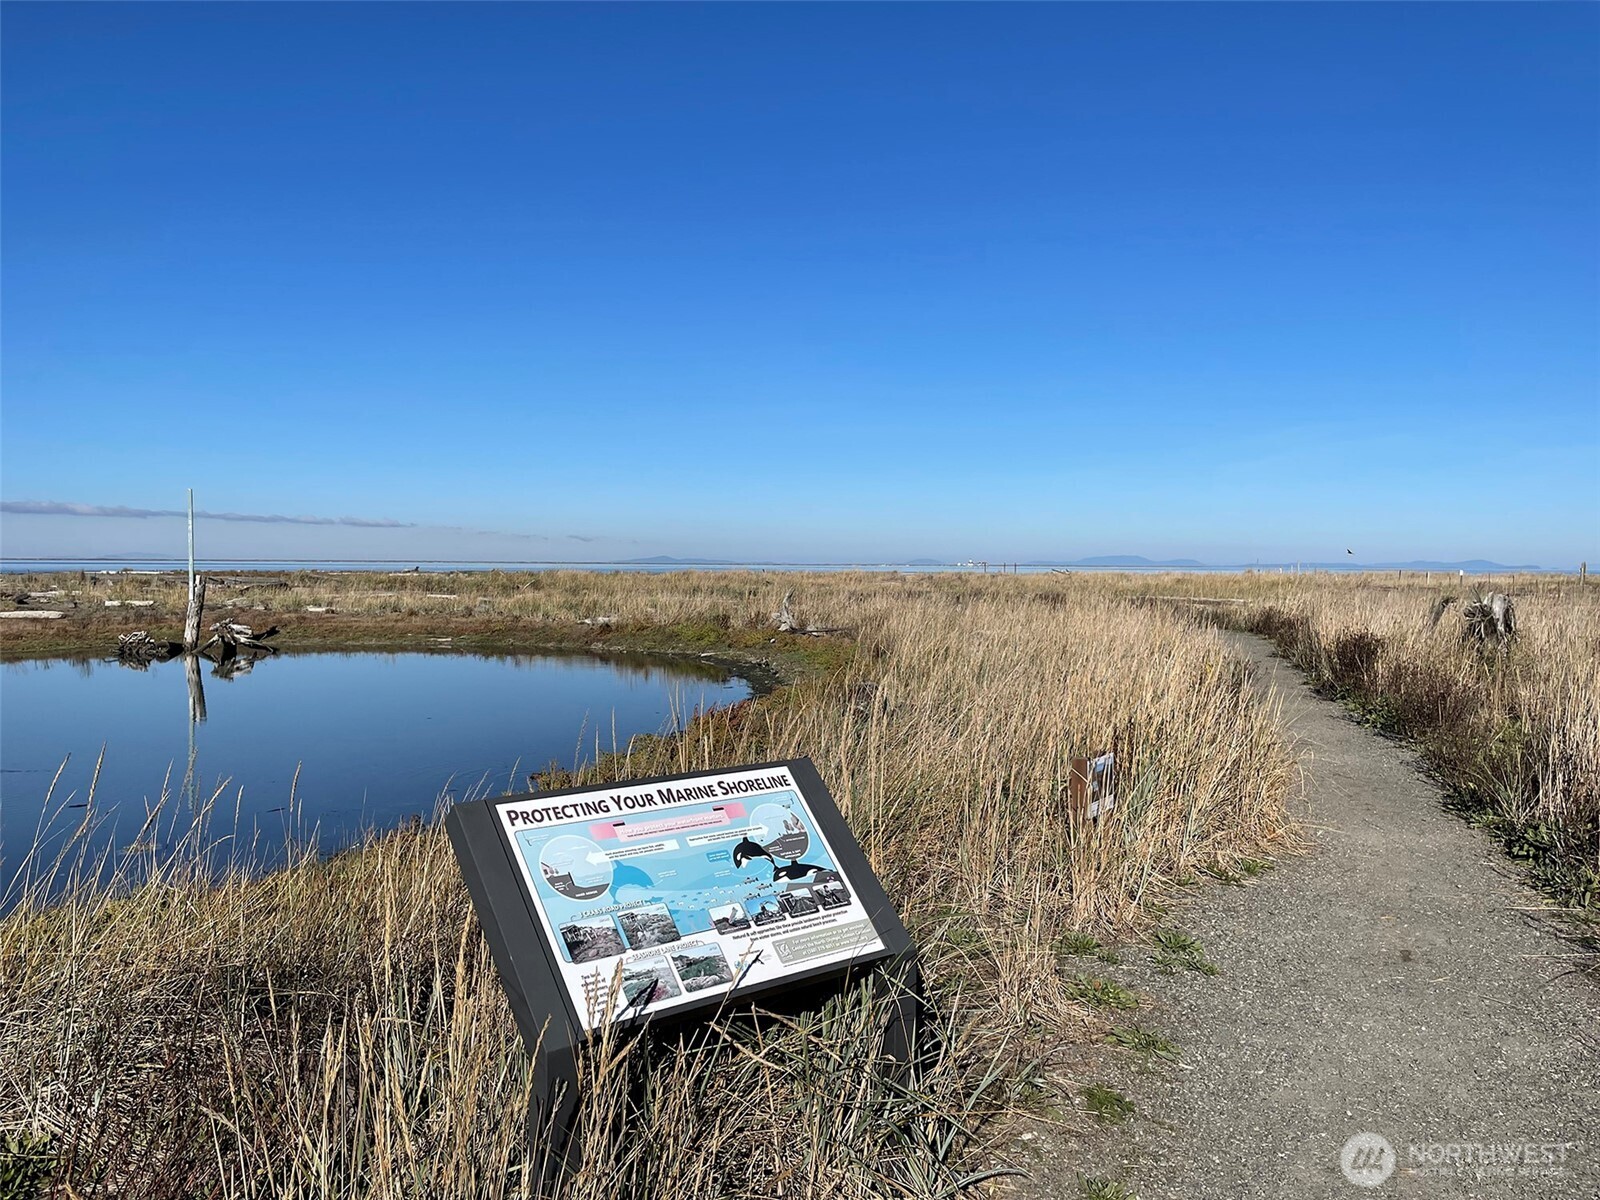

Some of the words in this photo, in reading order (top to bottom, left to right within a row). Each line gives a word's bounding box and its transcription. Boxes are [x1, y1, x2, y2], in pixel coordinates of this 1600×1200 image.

[507, 800, 609, 825] PROTECTING
[610, 793, 657, 810] YOUR
[657, 784, 717, 803] MARINE
[717, 775, 790, 795] SHORELINE
